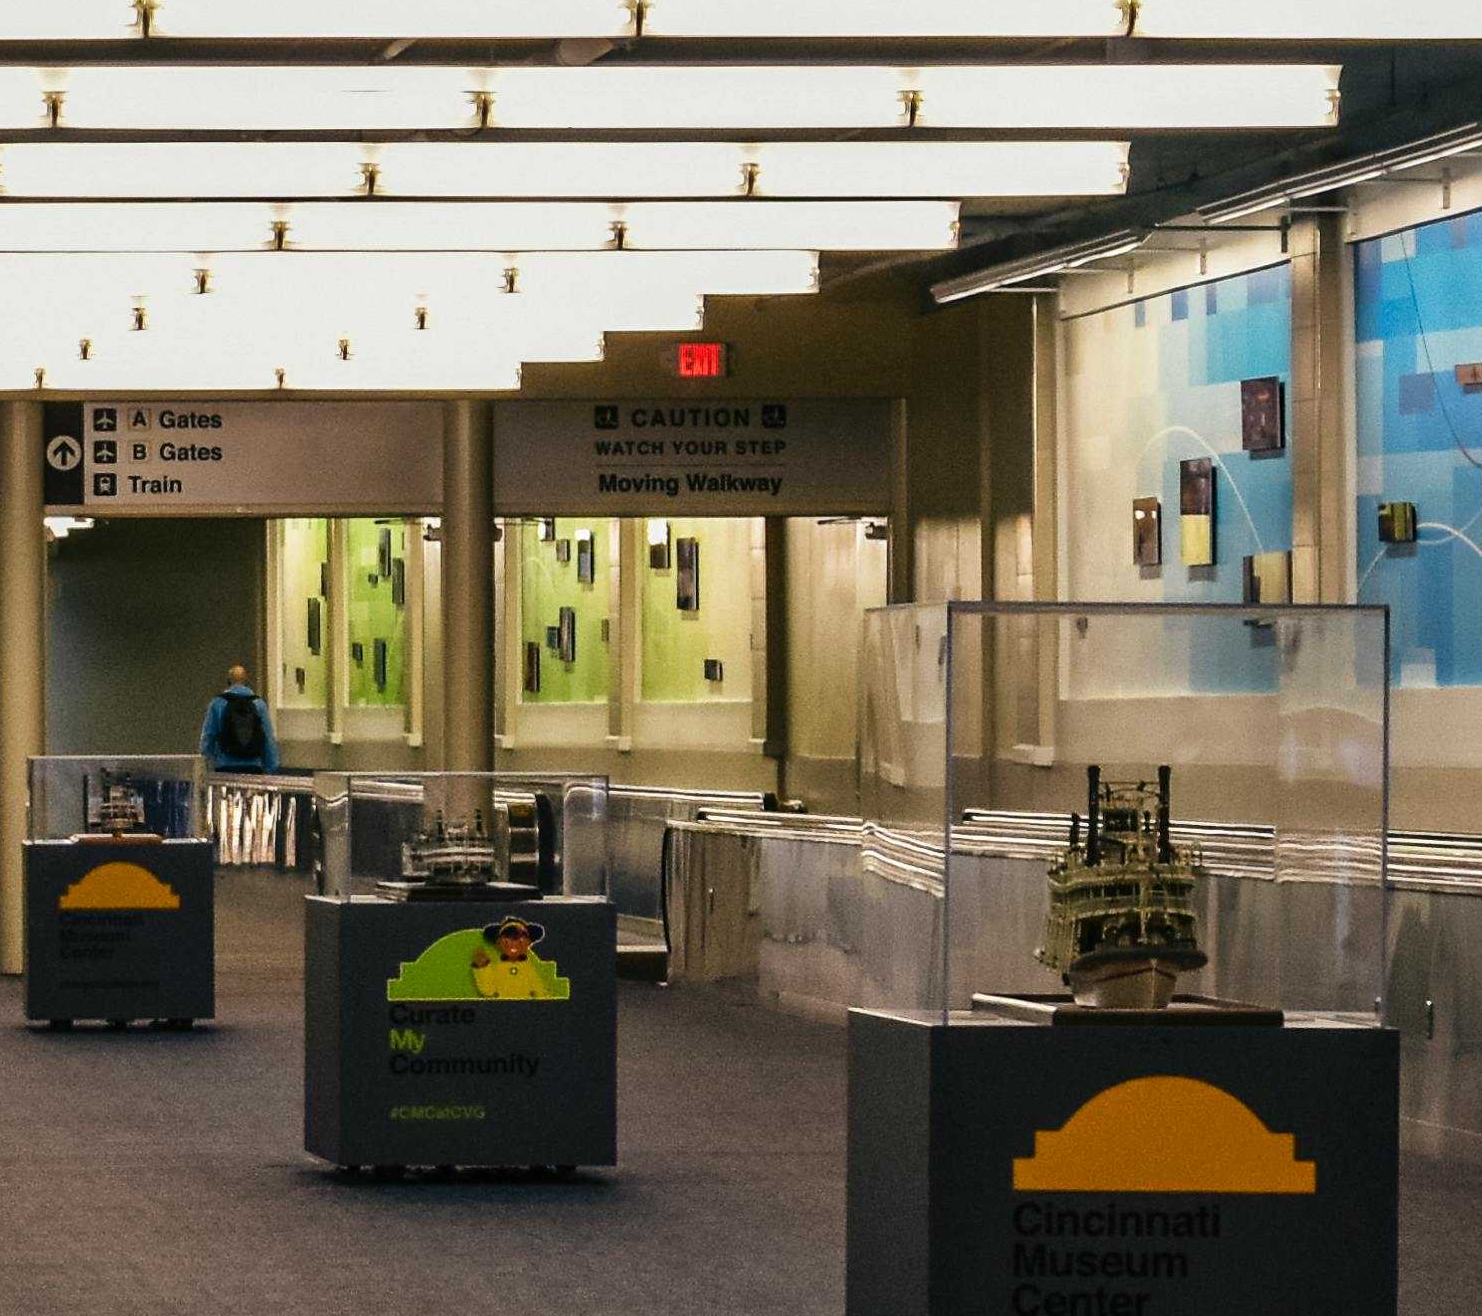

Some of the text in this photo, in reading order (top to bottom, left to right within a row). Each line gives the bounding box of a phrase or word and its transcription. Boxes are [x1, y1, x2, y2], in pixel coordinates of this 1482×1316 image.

[679, 343, 719, 377] EXIT
[132, 410, 222, 429] A Gates
[631, 408, 750, 428] CAUTION
[133, 443, 222, 461] B Gates
[595, 440, 787, 456] WATCH YOUR STEP
[128, 476, 182, 494] Train
[599, 473, 783, 497] Moving Walkway
[389, 1003, 476, 1025] Curate
[389, 1028, 425, 1054] My
[389, 1053, 540, 1078] Community
[1012, 1201, 1221, 1238] Cincinnati
[1012, 1242, 1189, 1278] Museum
